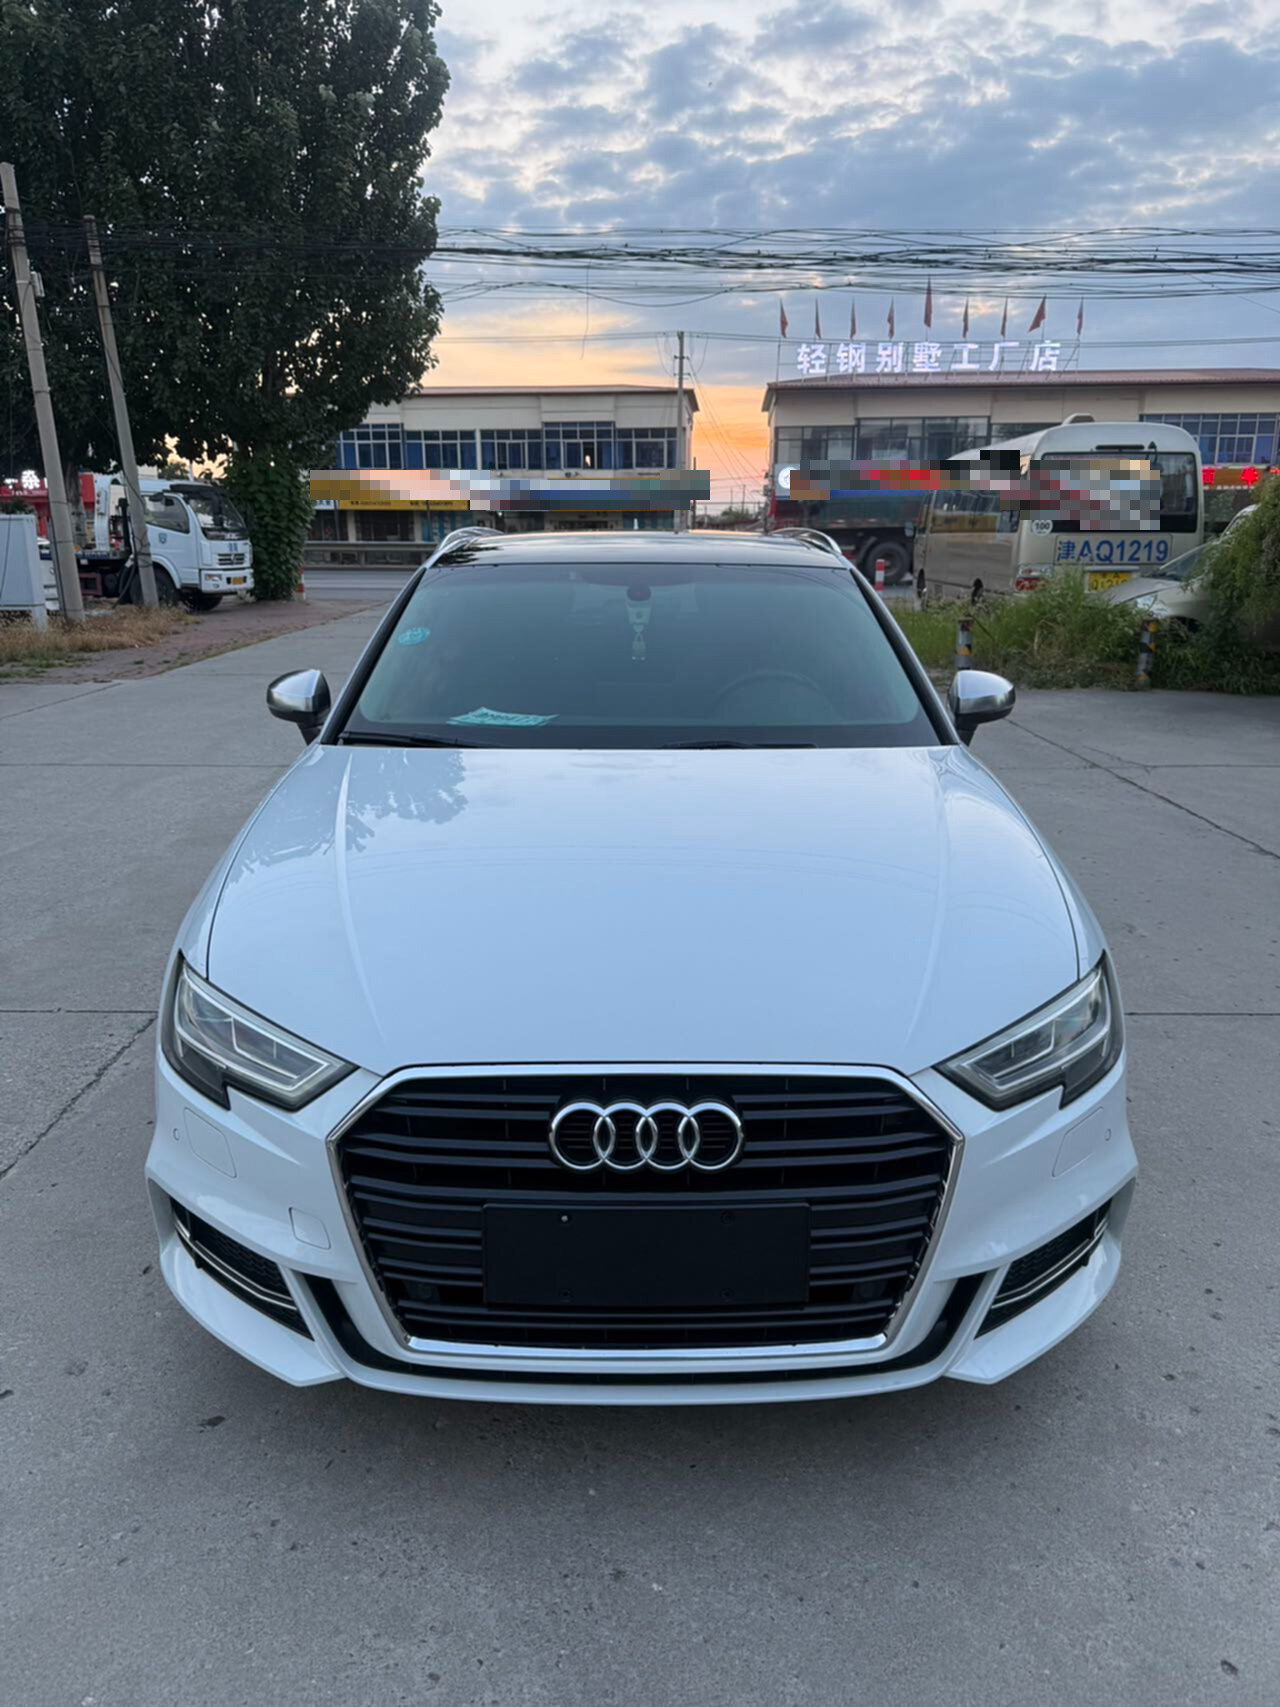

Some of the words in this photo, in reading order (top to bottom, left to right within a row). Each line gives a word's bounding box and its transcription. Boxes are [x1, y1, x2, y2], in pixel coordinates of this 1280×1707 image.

[797, 340, 1061, 374] 轻钢别墅工厂店
[1034, 522, 1050, 530] 100
[1057, 540, 1168, 562] 津AQ1219
